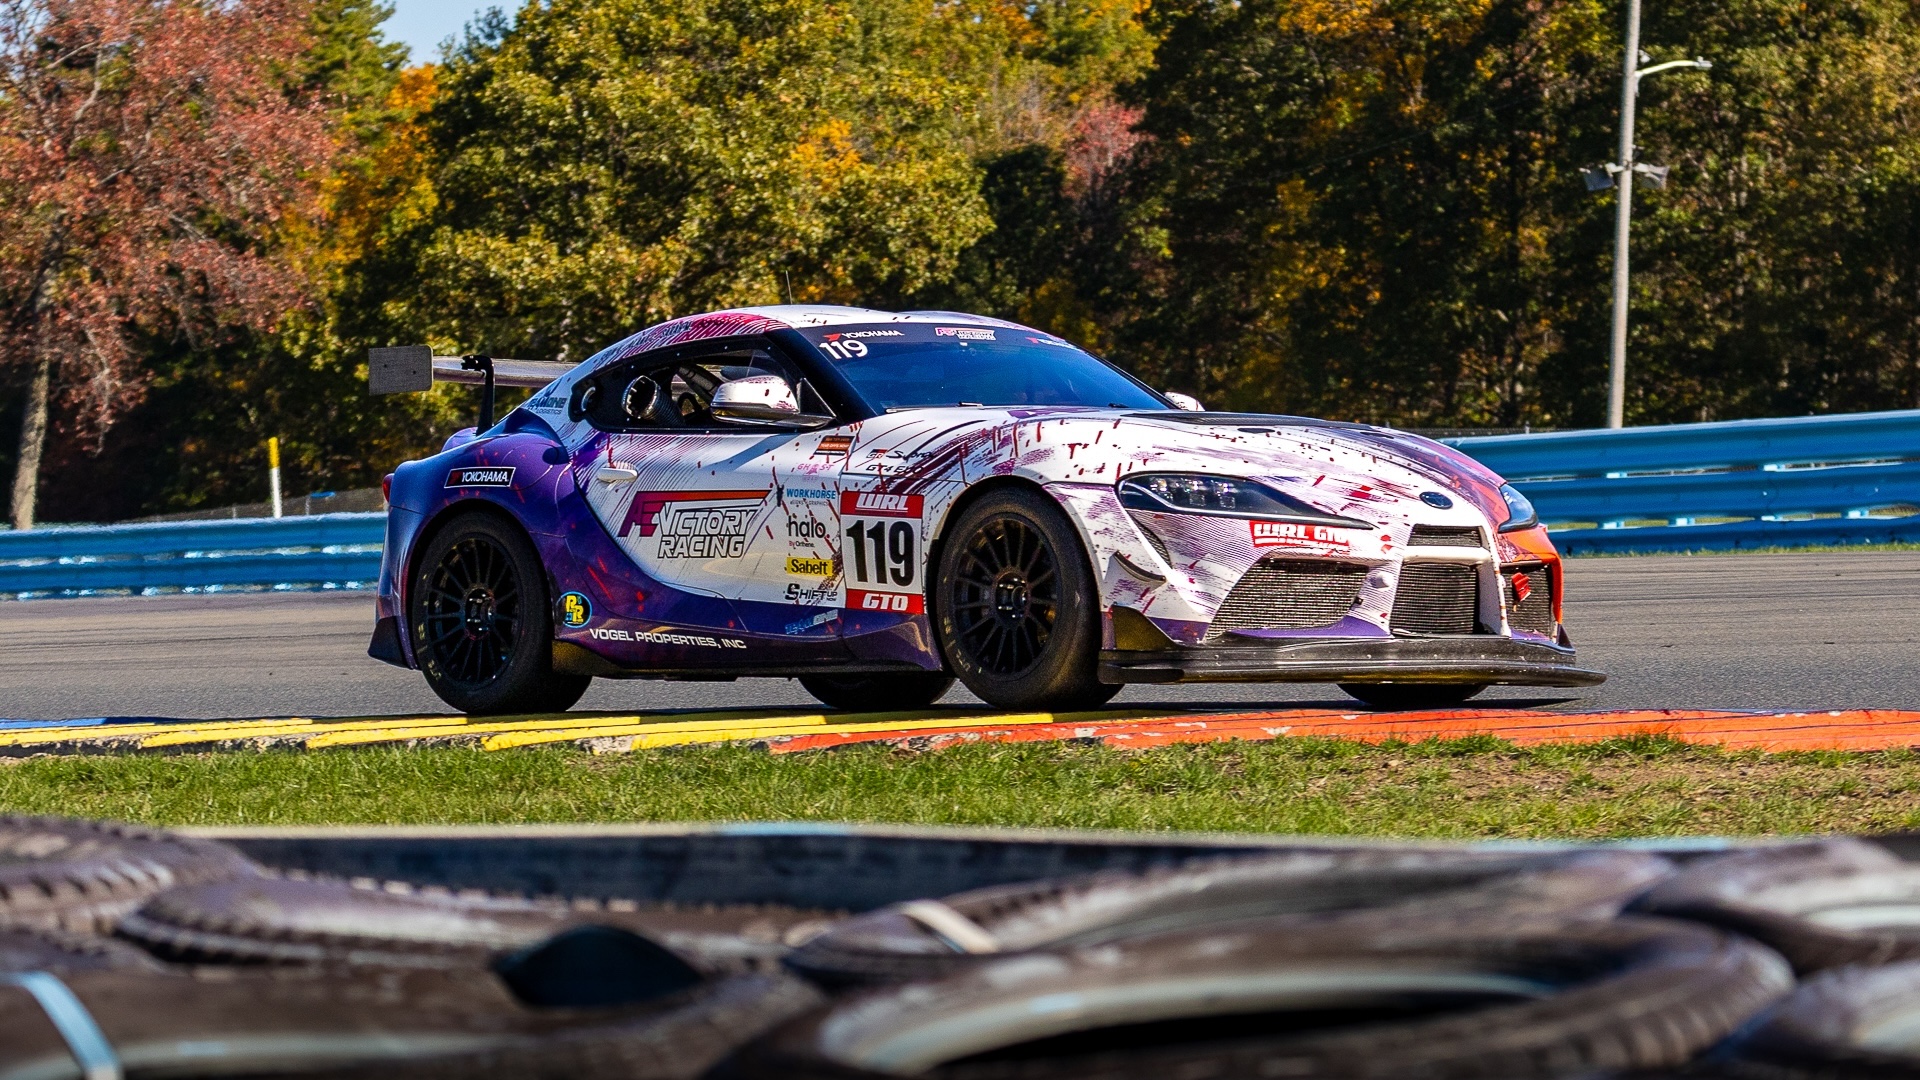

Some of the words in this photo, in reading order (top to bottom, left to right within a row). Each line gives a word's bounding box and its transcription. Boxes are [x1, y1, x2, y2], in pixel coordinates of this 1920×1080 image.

[842, 329, 904, 340] YOKOHAMA
[818, 339, 869, 360] 119
[461, 471, 509, 483] YOKOHAMA
[786, 488, 837, 500] WORKHORSE
[855, 493, 909, 511] WRL
[657, 502, 756, 536] VICTORY
[1253, 523, 1309, 540] WRL
[657, 535, 745, 558] RACING
[846, 519, 914, 586] 119
[791, 558, 829, 575] Sabelt
[784, 583, 827, 602] SHIFT
[862, 593, 909, 612] GTO
[589, 628, 634, 641] VOGEL
[635, 631, 722, 648] PROPERTIES,
[722, 637, 747, 649] INC
